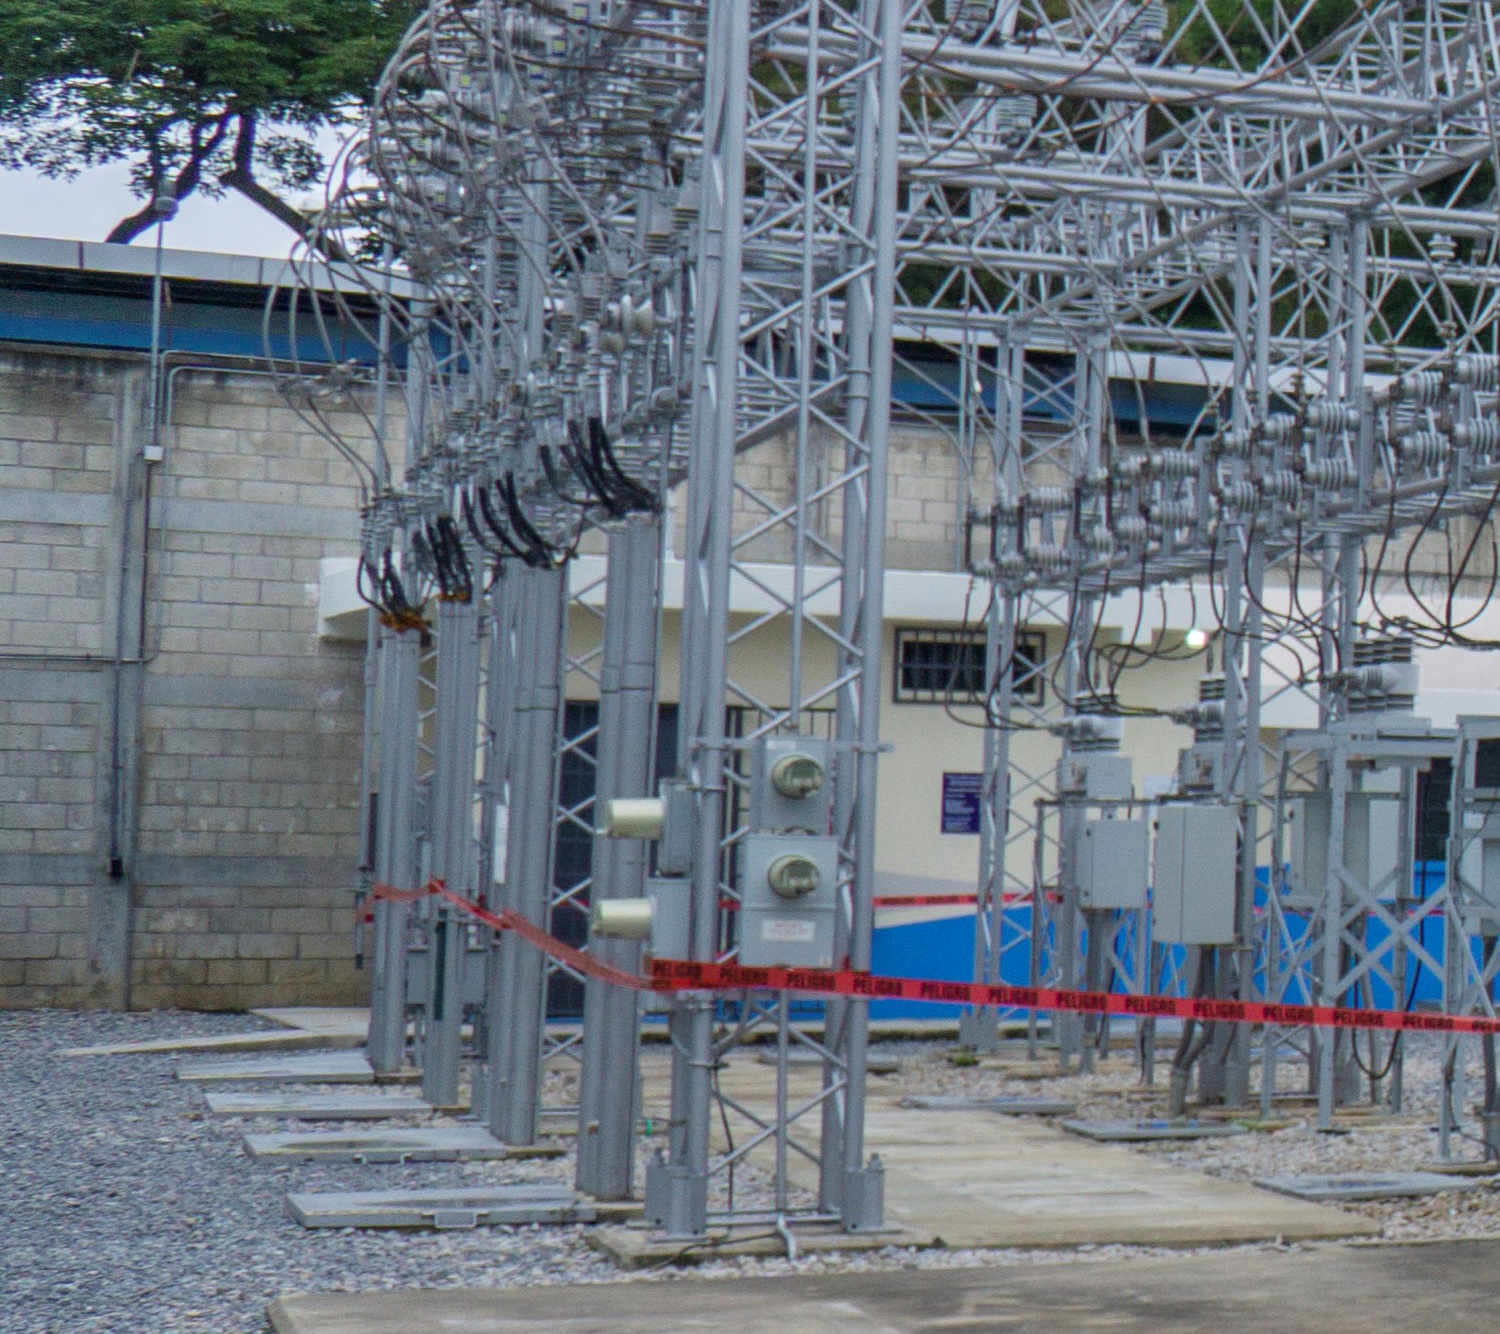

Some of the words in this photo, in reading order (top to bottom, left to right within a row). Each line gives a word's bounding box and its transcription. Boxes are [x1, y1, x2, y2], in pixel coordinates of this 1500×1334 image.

[786, 972, 836, 990] PELIGRO
[853, 977, 903, 996] PELIGRO
[920, 982, 971, 1001] PELIGRO
[988, 986, 1038, 1006] PELIGRO
[1056, 991, 1107, 1010] PELIGRO
[1125, 995, 1176, 1014] PELIGRO
[1193, 1000, 1245, 1019] PELIGRO
[1263, 1005, 1314, 1022] PELIGRO
[1332, 1009, 1384, 1026] PELIGRO
